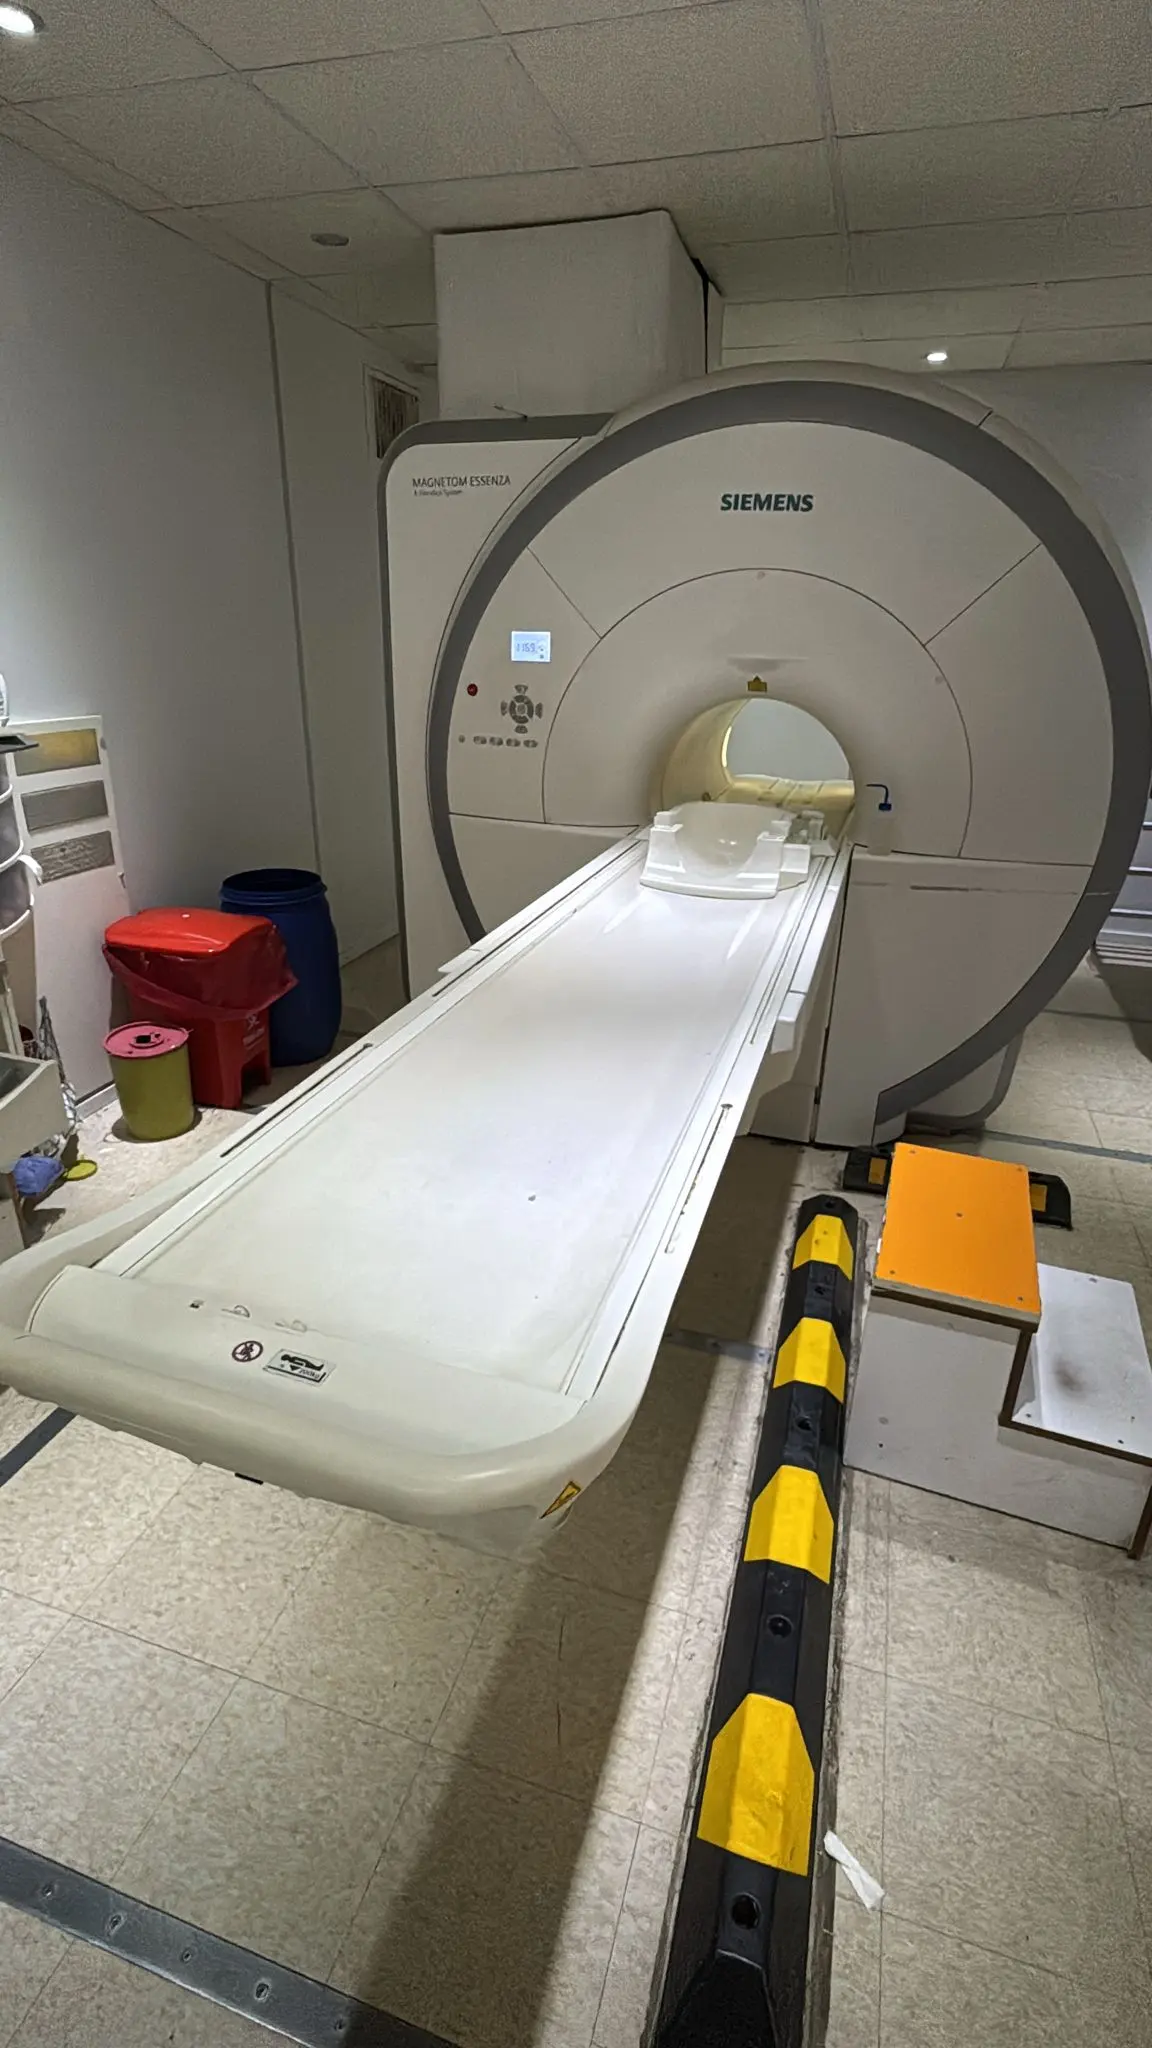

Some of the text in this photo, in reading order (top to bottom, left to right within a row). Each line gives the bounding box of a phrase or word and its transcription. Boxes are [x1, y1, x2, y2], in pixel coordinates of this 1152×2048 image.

[412, 474, 511, 488] MAGNETOM ESSENZA
[720, 493, 814, 512] SIEMENS
